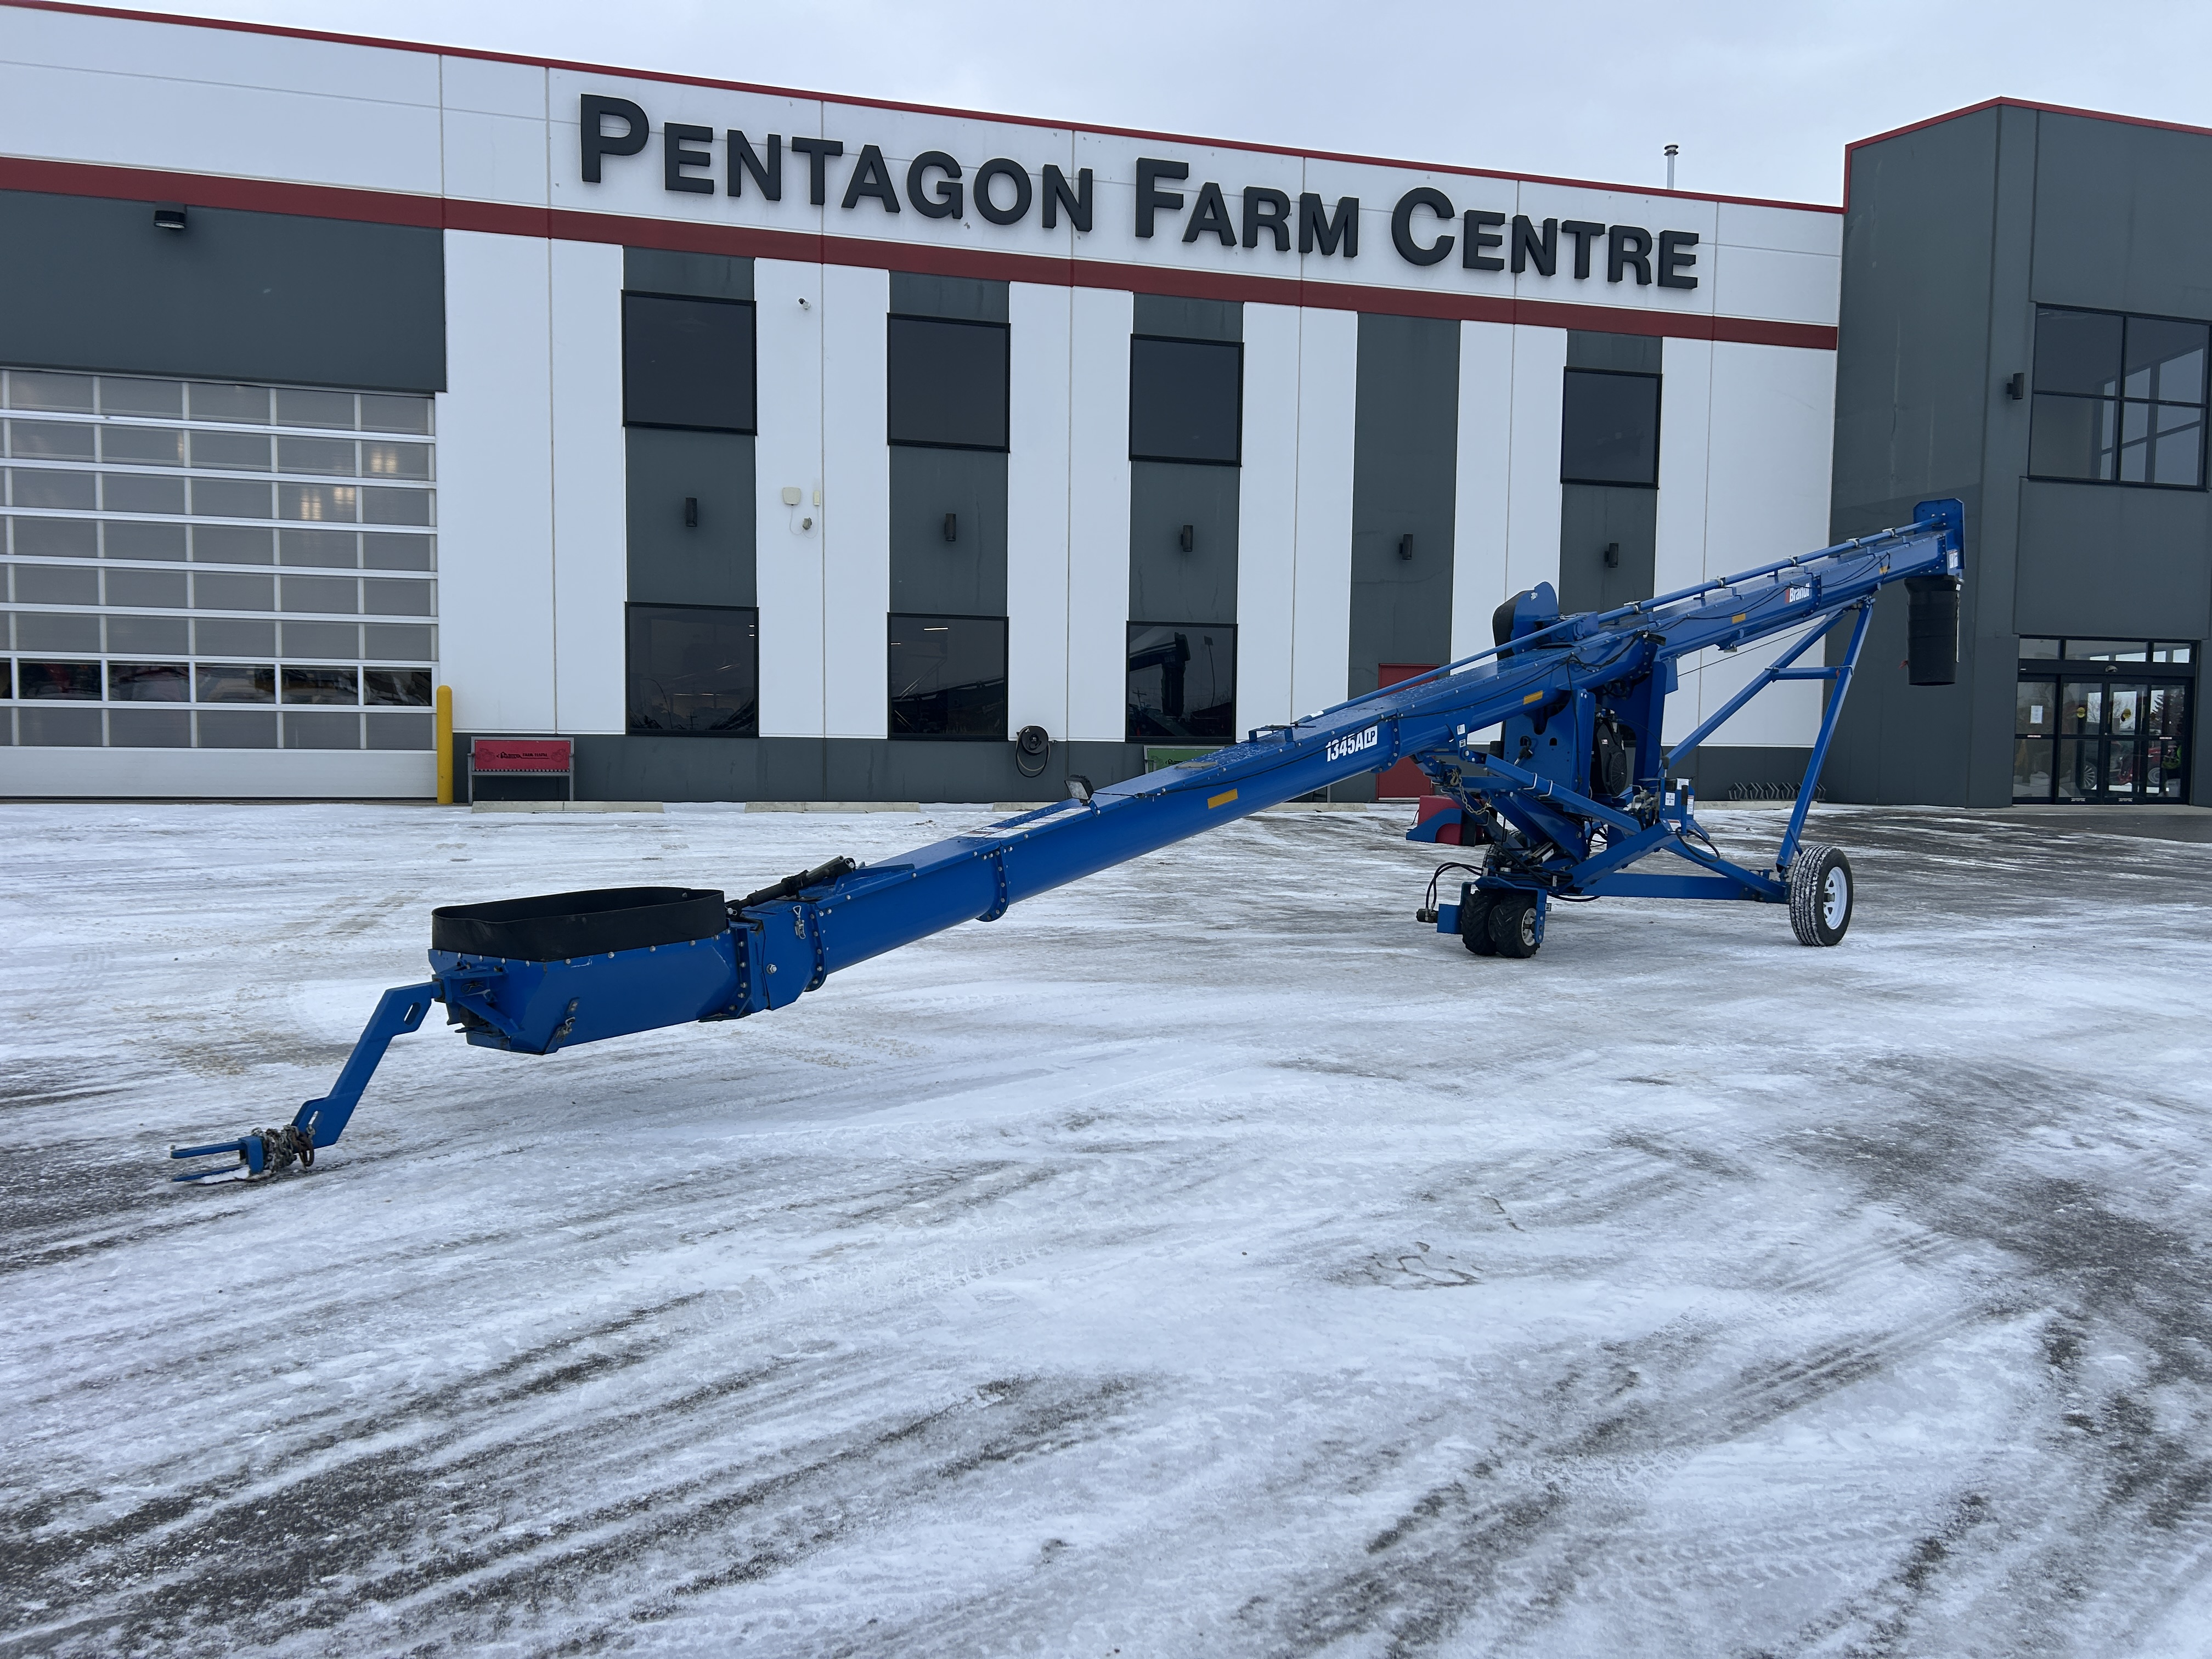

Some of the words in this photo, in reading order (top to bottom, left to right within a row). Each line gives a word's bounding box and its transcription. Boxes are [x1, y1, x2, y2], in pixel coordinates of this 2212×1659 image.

[580, 93, 1093, 233] PENTAGON
[1135, 157, 1360, 261] FARM
[1390, 187, 1700, 290] CENTRE
[1790, 583, 1810, 603] Brandt
